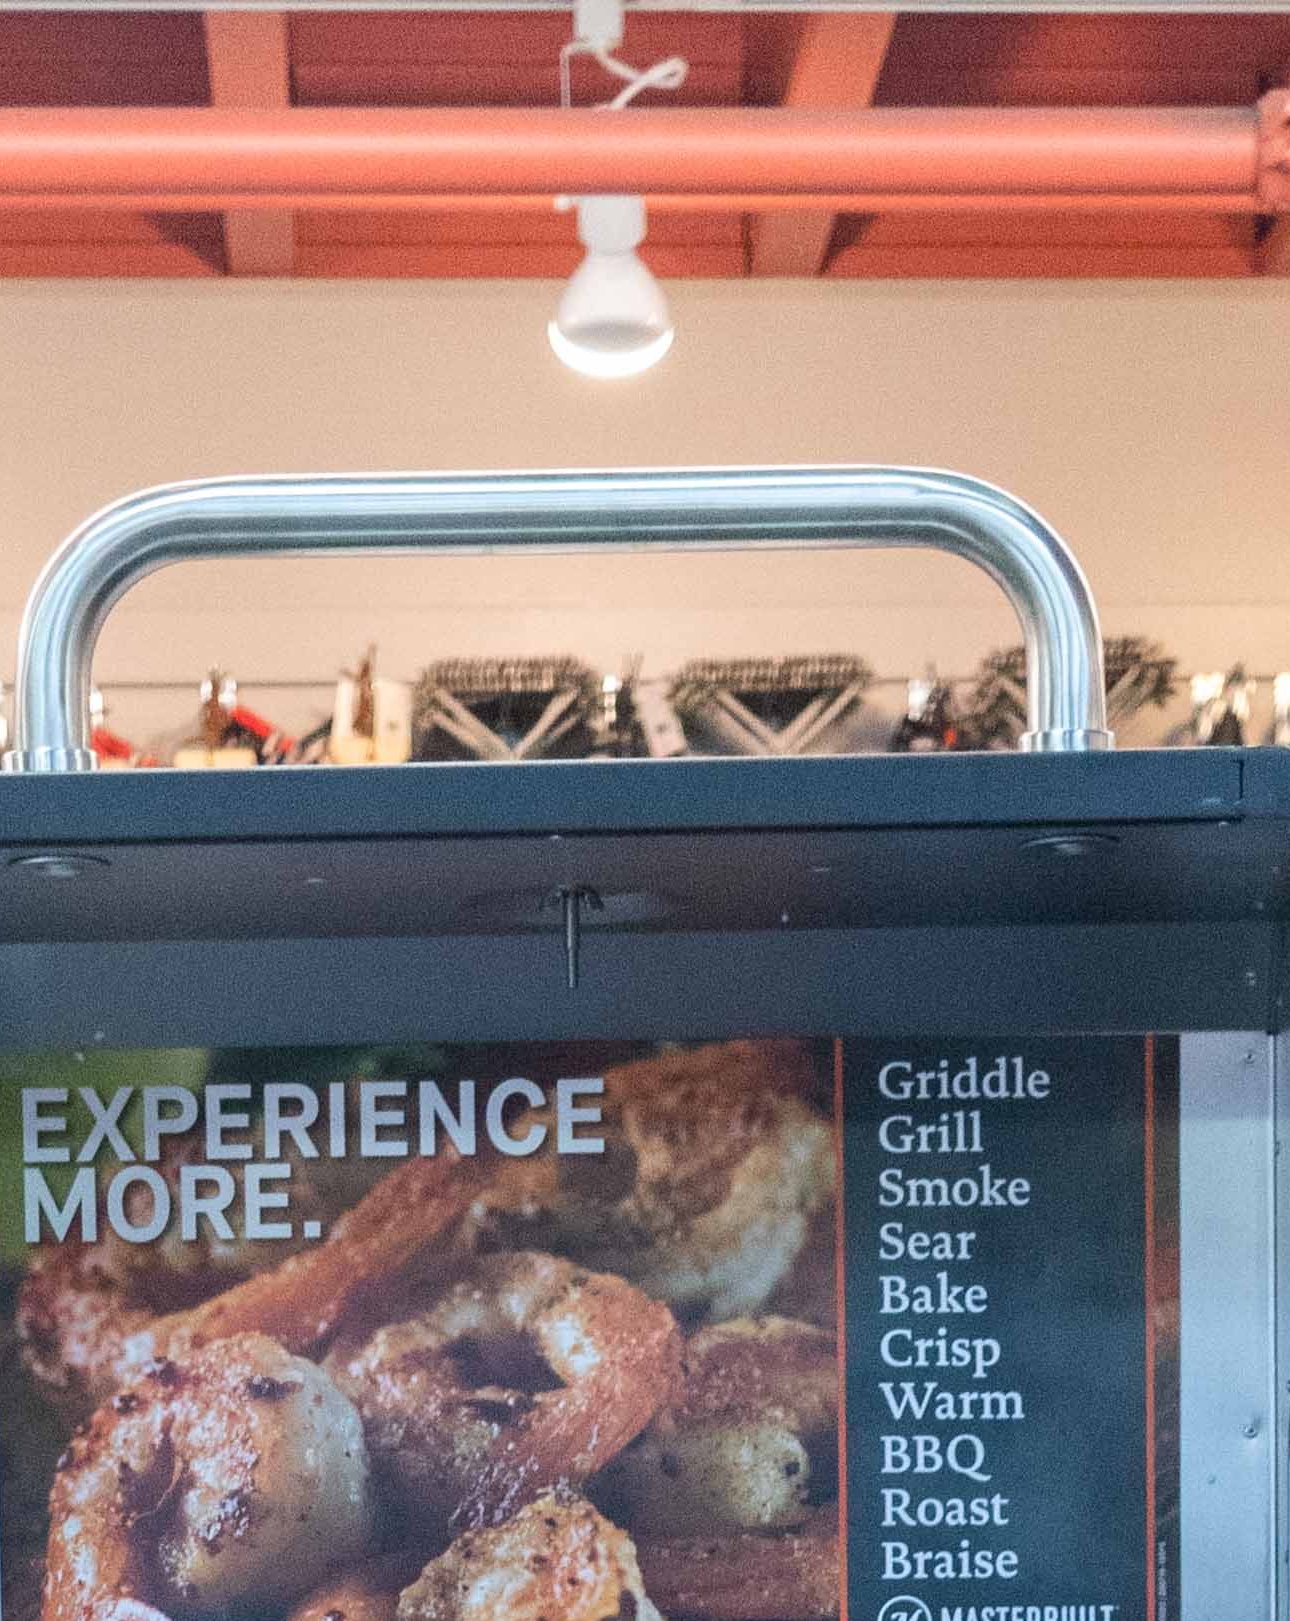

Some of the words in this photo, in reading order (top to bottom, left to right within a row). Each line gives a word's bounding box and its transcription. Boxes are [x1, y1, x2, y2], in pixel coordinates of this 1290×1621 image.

[878, 1056, 1051, 1100] Griddle
[21, 1078, 605, 1163] EXPERIENCE
[878, 1110, 984, 1153] Grill
[23, 1163, 322, 1243] MORE.
[878, 1163, 1031, 1207] Smoke
[879, 1222, 976, 1260] Sear
[879, 1271, 988, 1314] Bake
[880, 1327, 1001, 1378] Crisp
[878, 1382, 1025, 1420] Warm
[880, 1434, 992, 1482] BBQ
[881, 1488, 1010, 1527] Roast
[881, 1539, 1019, 1580] Braise
